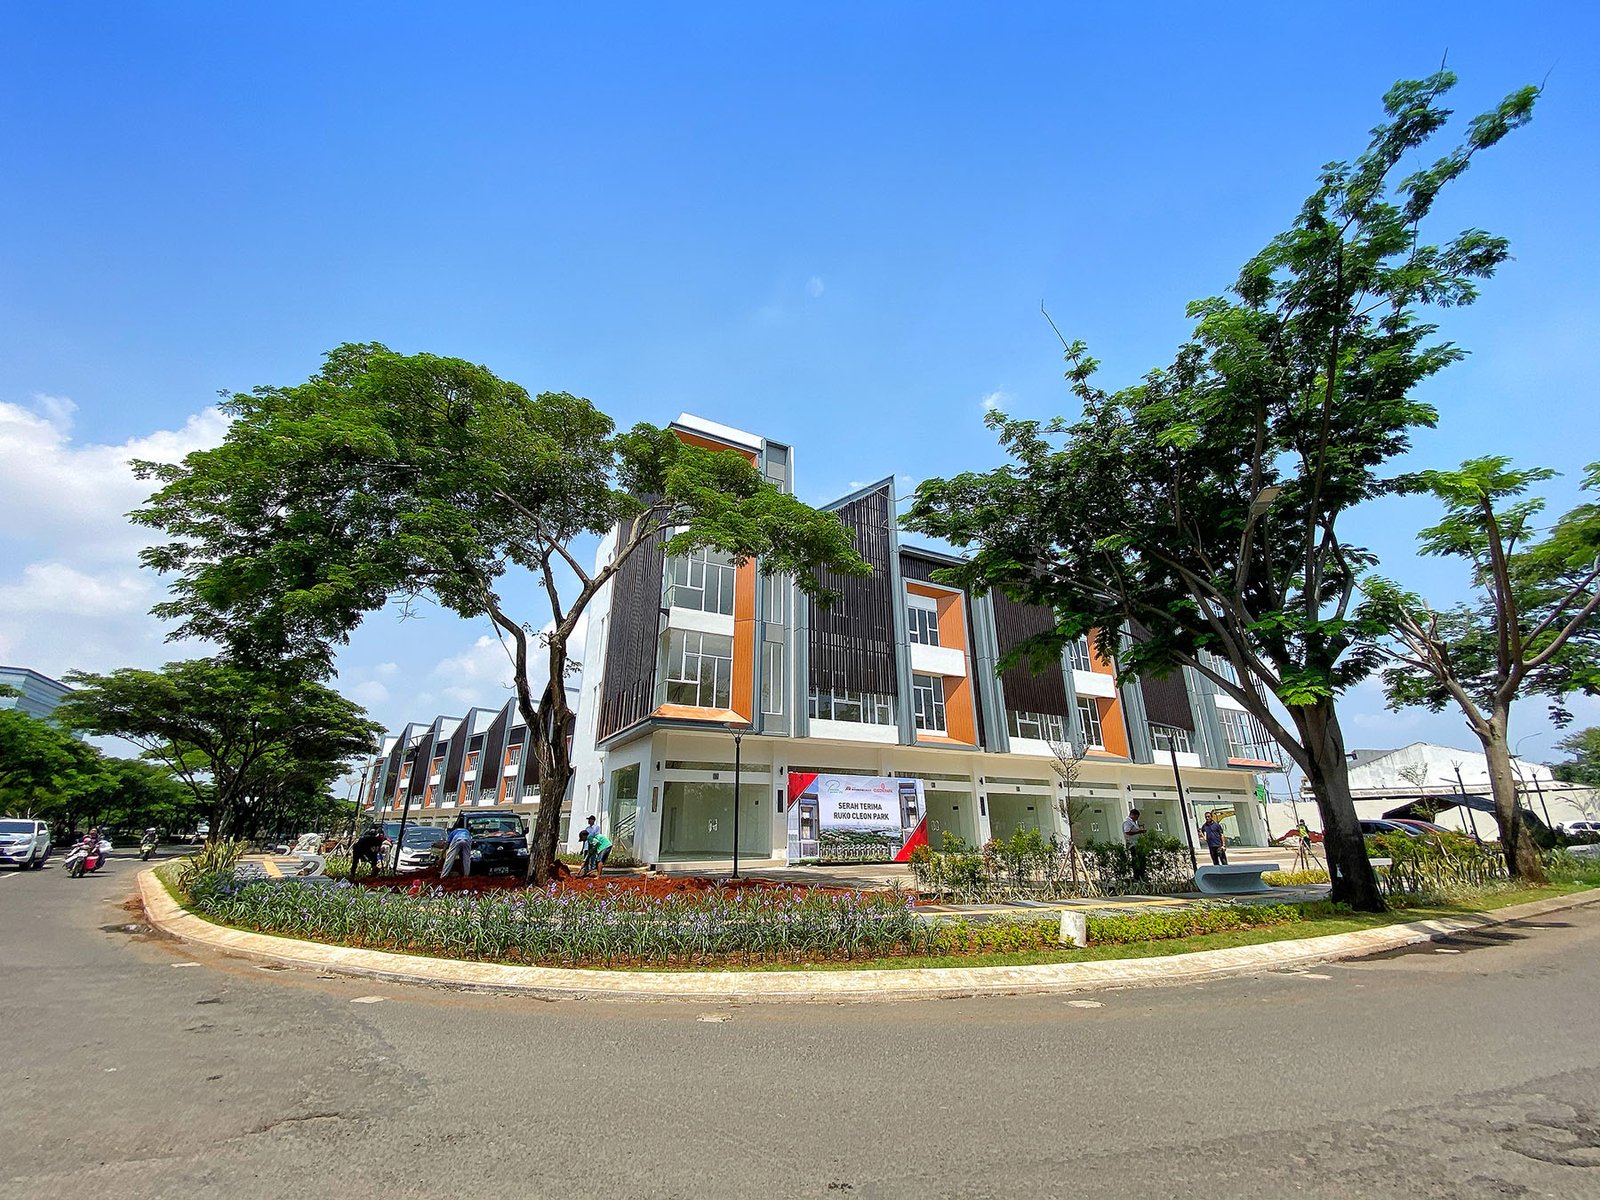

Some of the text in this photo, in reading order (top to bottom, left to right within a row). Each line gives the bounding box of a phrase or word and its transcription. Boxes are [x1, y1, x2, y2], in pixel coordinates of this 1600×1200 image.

[838, 802, 882, 810] SERAH TERIMA
[833, 812, 851, 820] RUKO
[852, 812, 872, 820] CLEON
